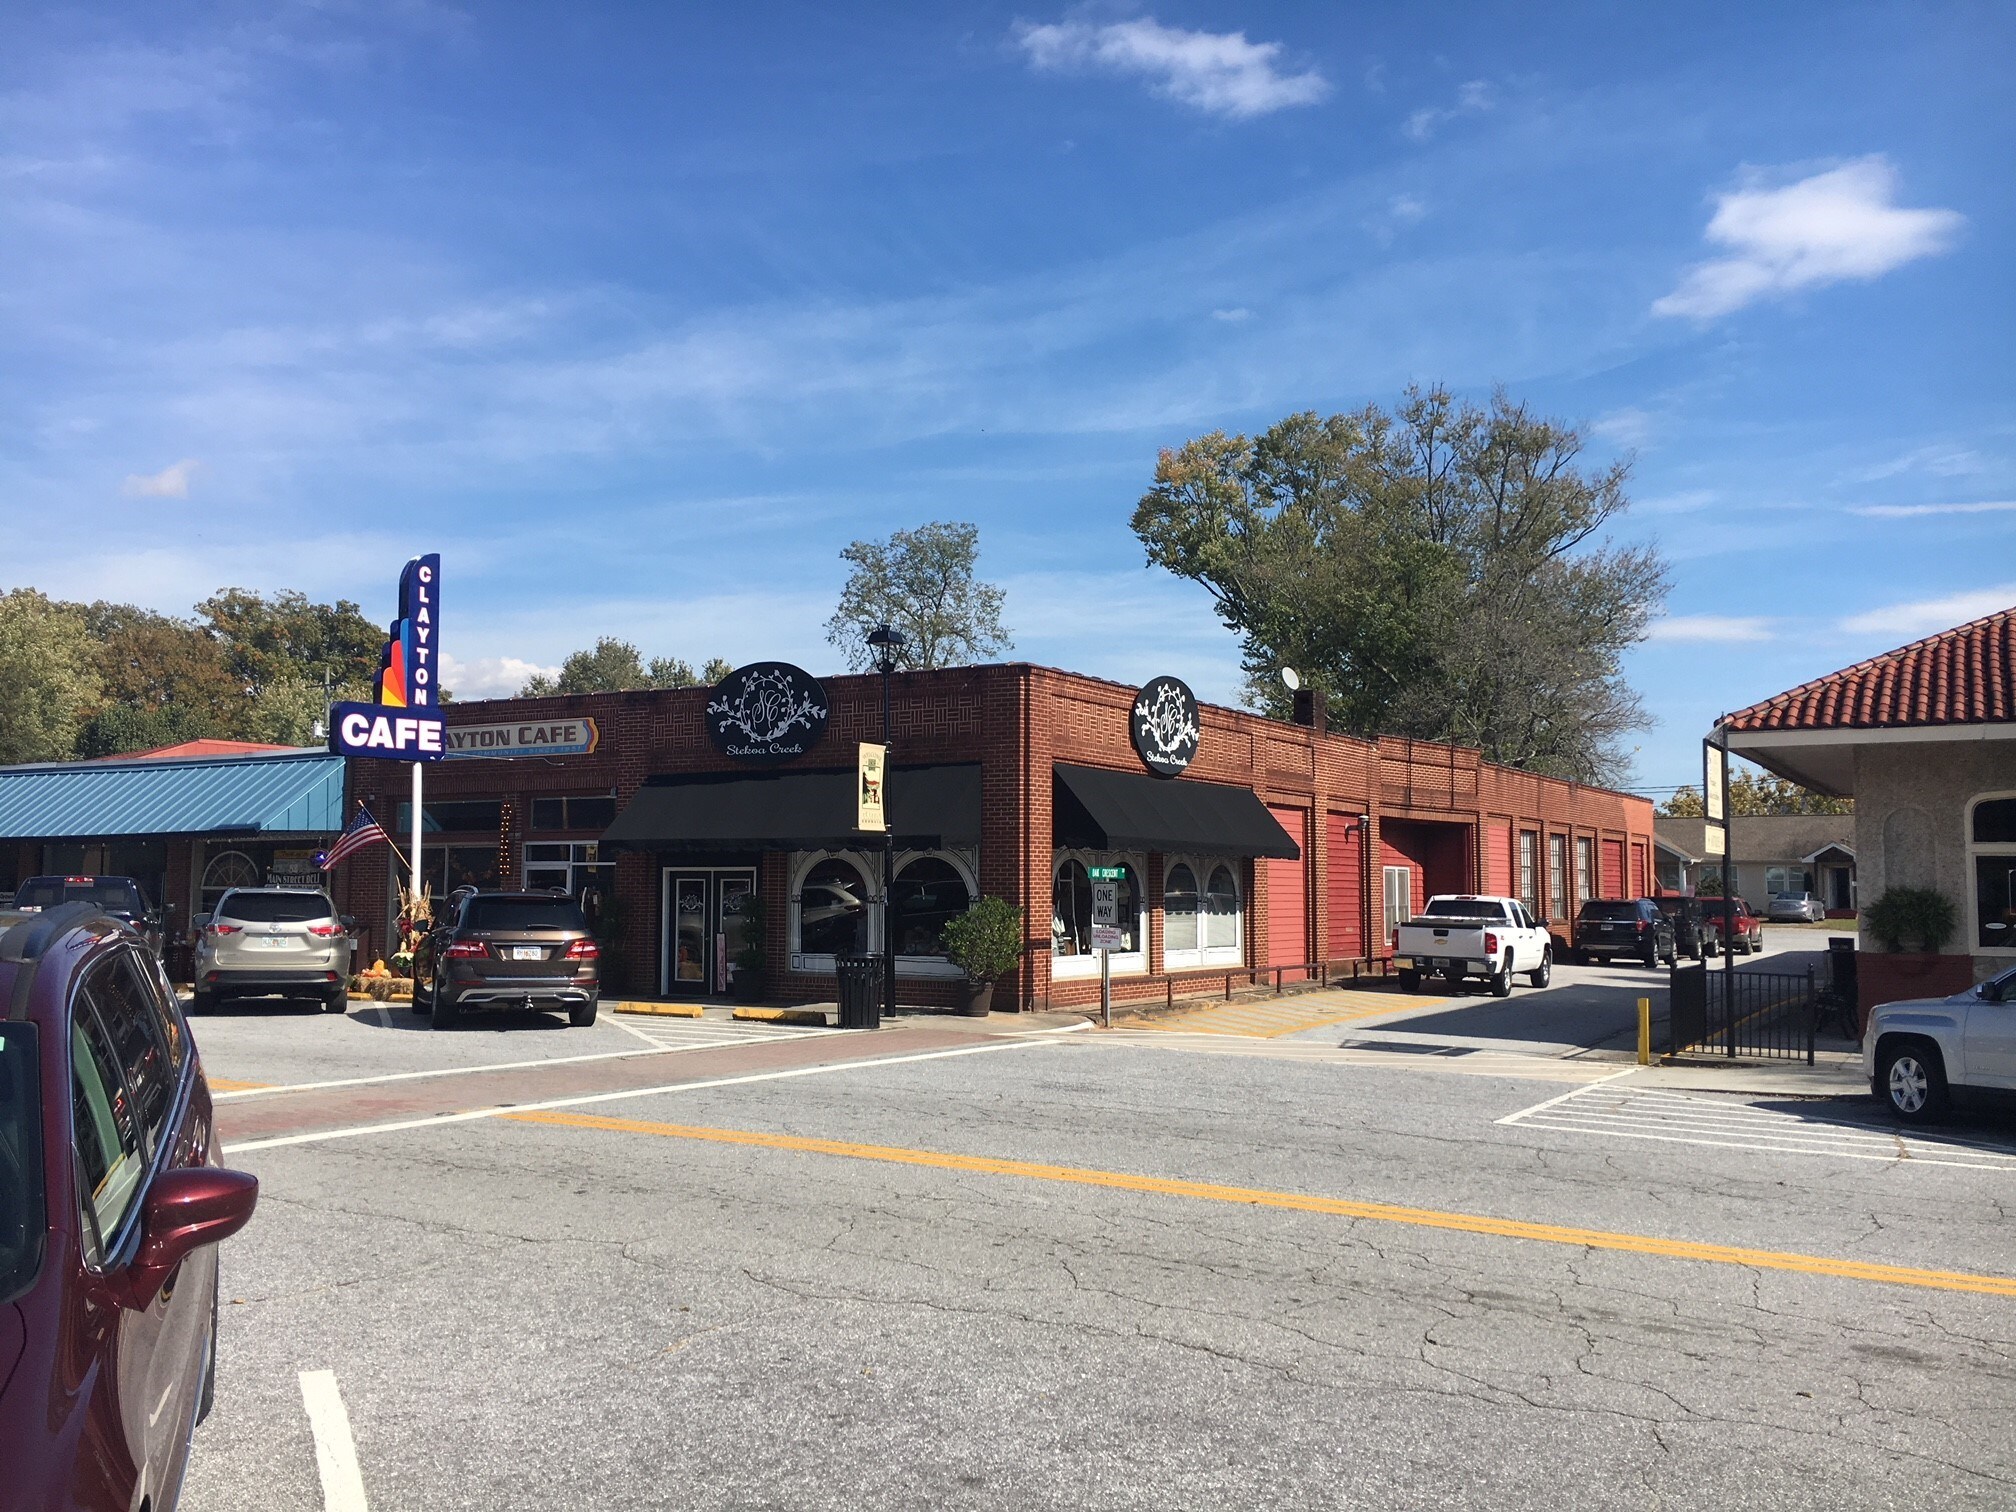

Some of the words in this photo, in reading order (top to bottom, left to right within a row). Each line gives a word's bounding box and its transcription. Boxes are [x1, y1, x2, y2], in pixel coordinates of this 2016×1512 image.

[415, 566, 432, 706] CLAYTON
[341, 713, 442, 752] CAFE
[445, 729, 511, 749] AYTON
[518, 725, 577, 745] CAFE
[475, 748, 524, 756] OMMUNITY
[727, 744, 767, 756] Stekoa
[769, 742, 803, 754] Creek
[266, 873, 282, 884] MAIN
[282, 875, 305, 884] STREET
[306, 872, 320, 884] DELI
[1096, 889, 1113, 902] ONE
[1096, 905, 1113, 918] WAY
